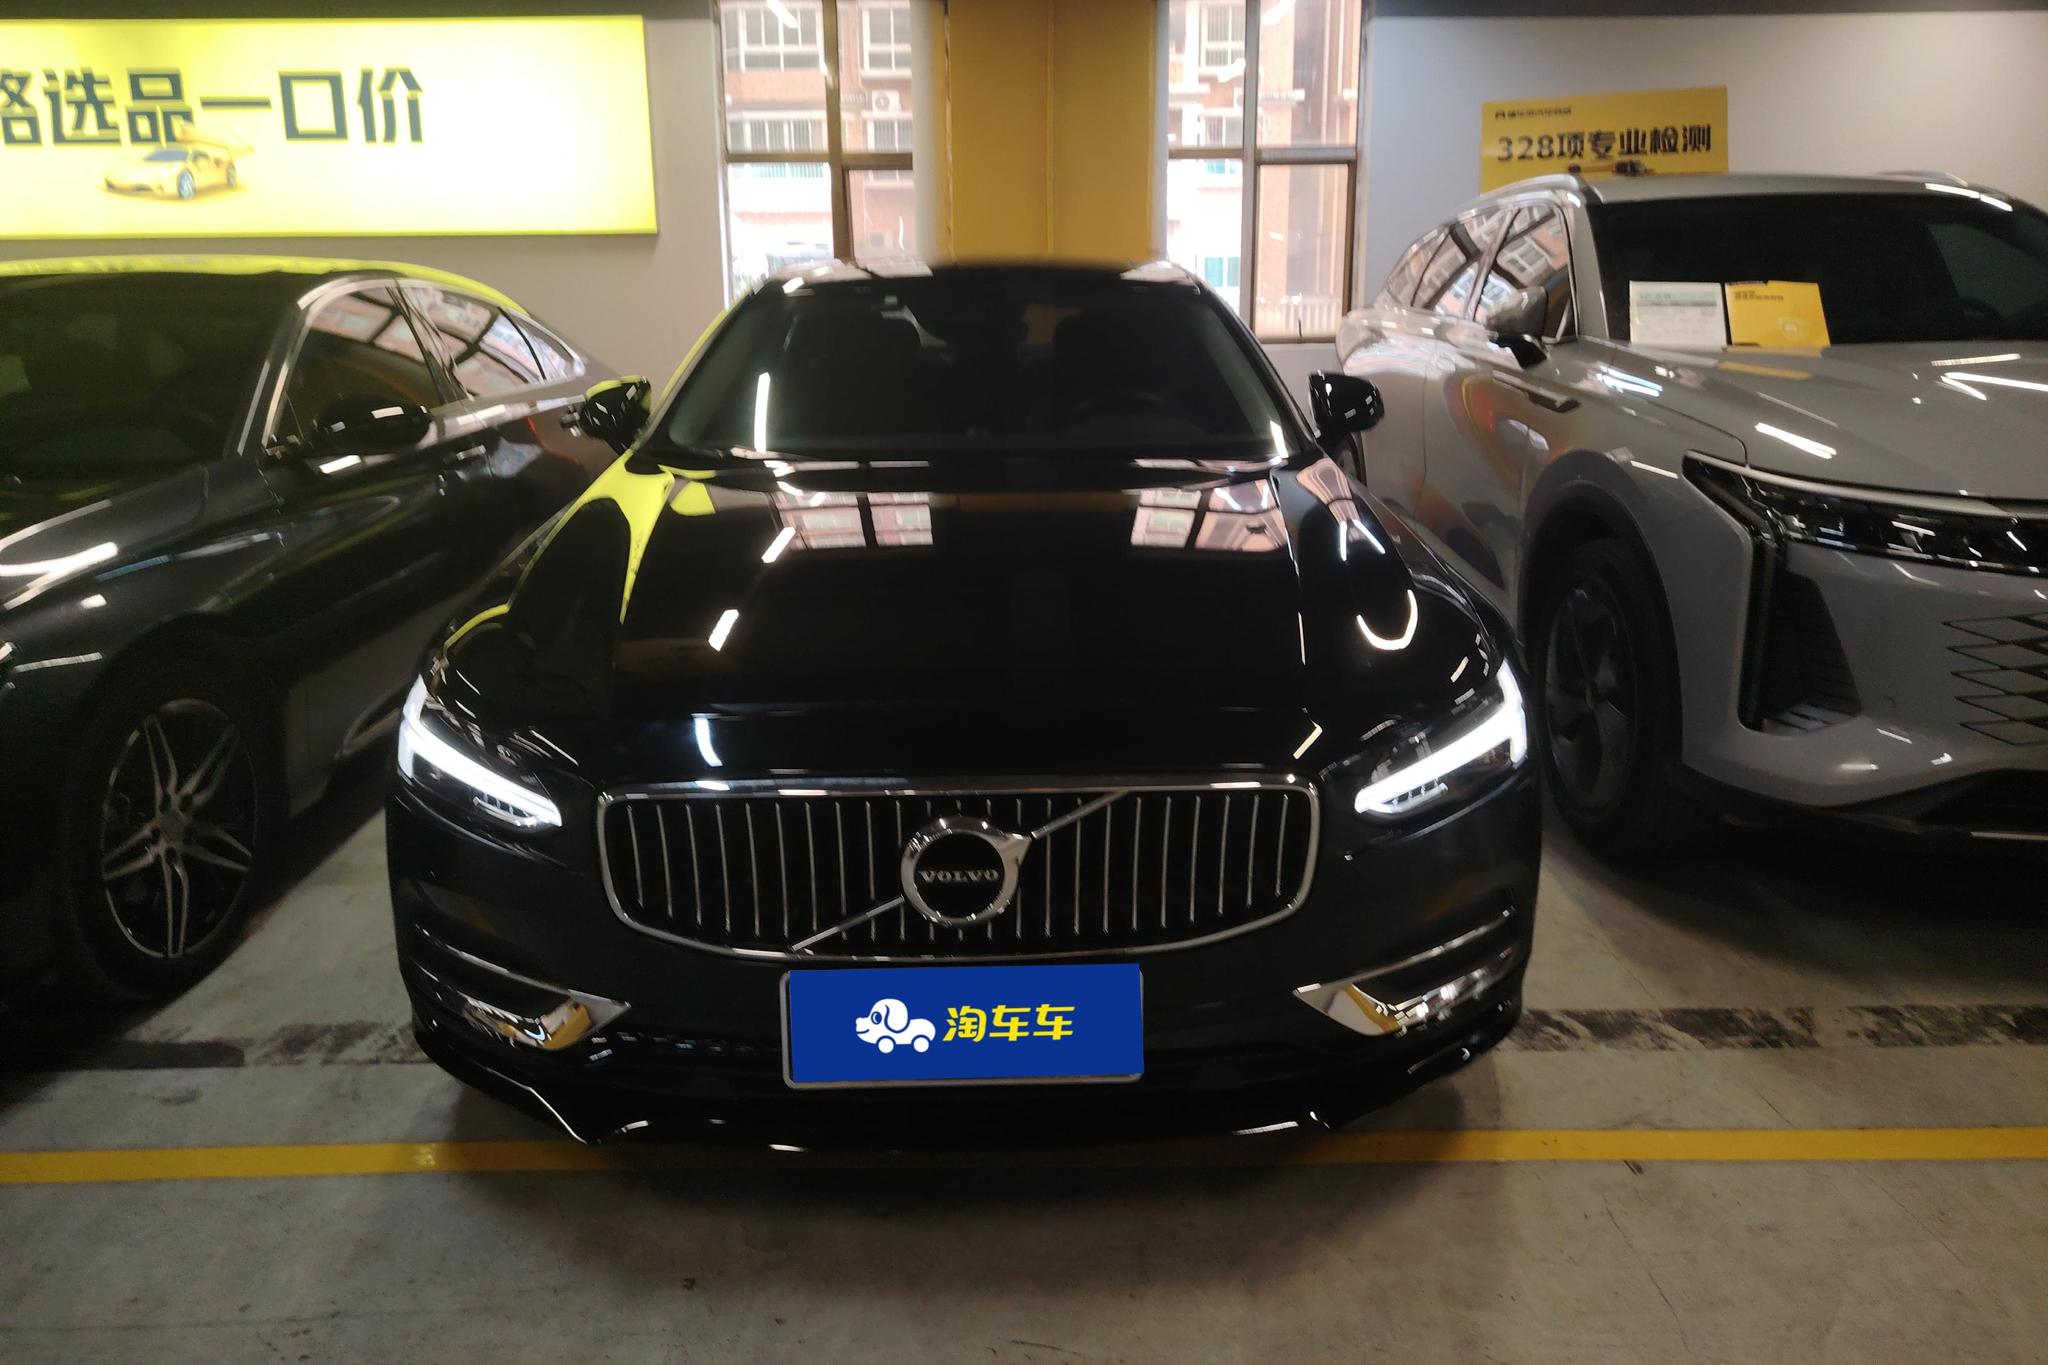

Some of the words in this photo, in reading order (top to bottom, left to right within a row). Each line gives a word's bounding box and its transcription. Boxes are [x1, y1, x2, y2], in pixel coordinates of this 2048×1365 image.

[1497, 124, 1712, 161] 328项专业检测
[919, 869, 999, 883] VOLVO
